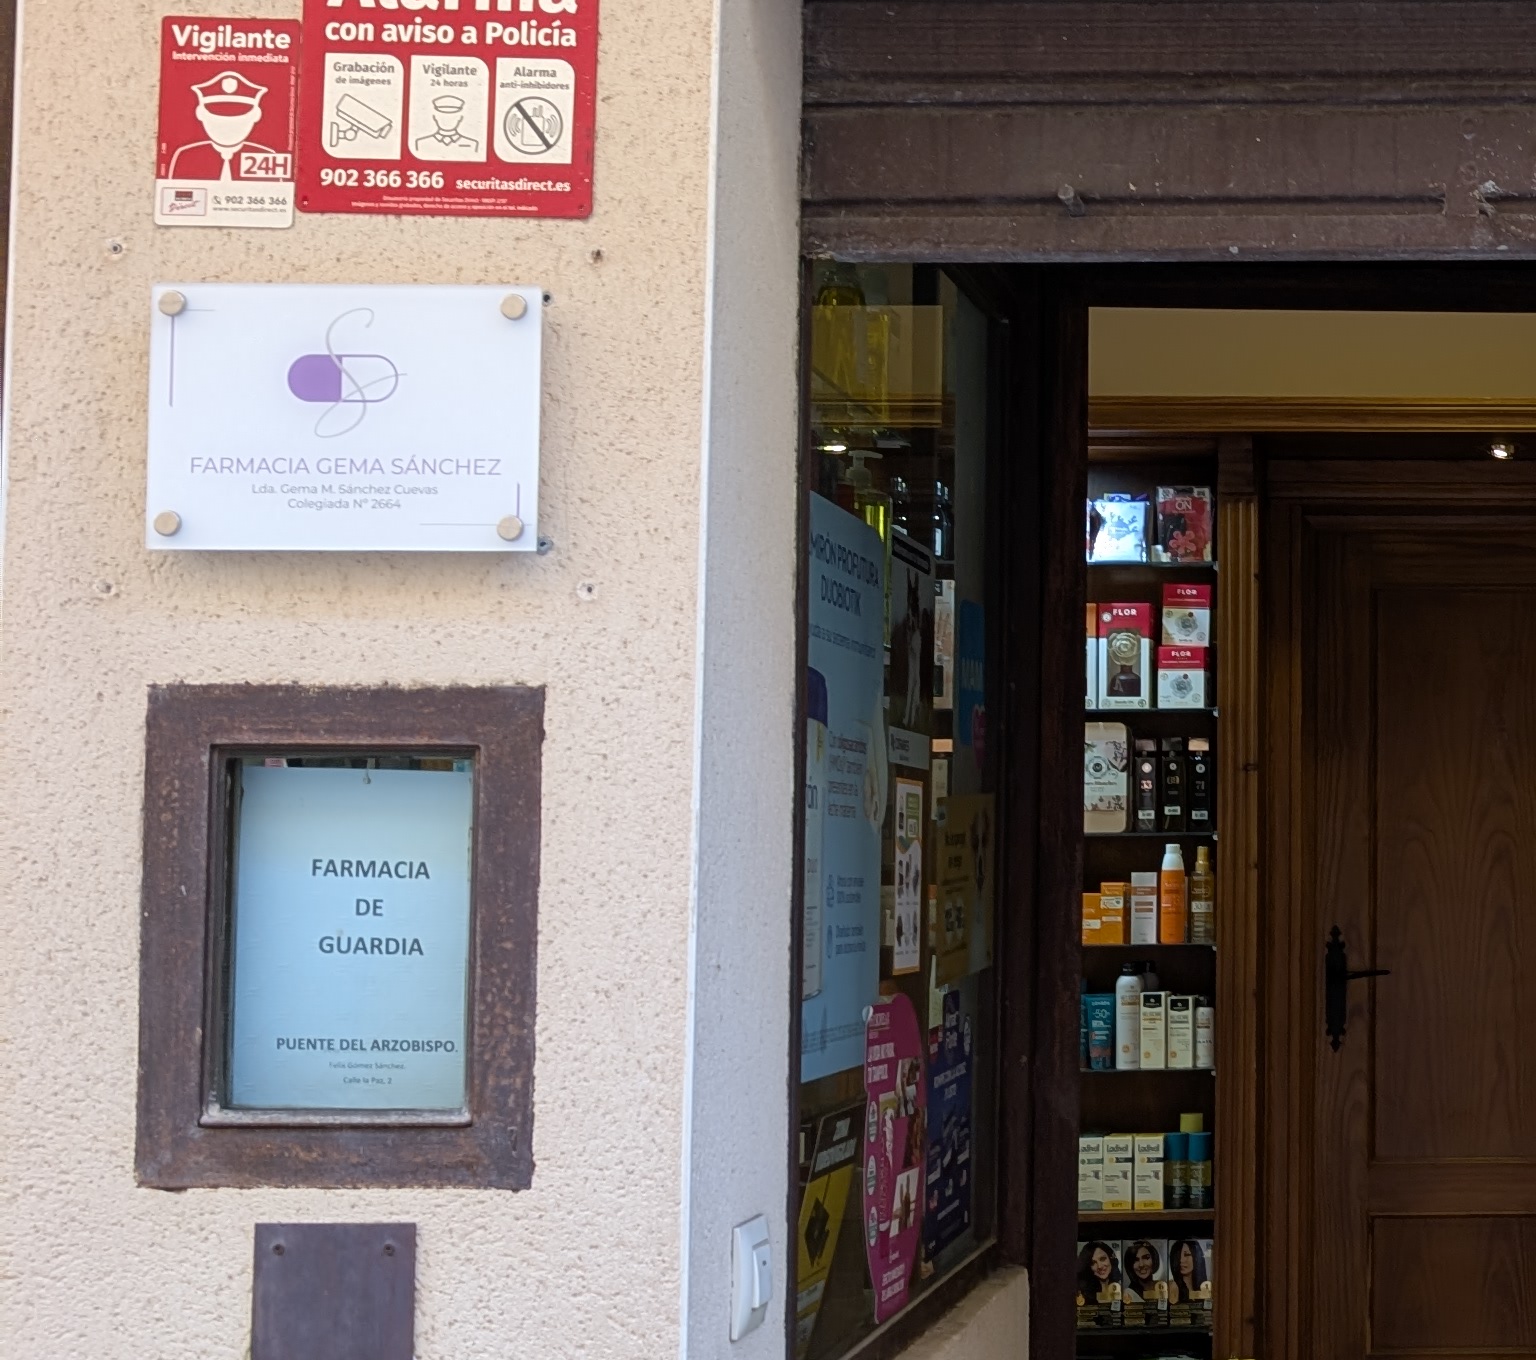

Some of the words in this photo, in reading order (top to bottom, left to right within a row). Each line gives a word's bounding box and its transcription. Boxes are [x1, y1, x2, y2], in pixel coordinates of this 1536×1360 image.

[172, 25, 291, 54] Vigilante
[325, 22, 375, 43] con
[381, 17, 454, 44] aviso
[461, 26, 478, 45] a
[485, 19, 577, 48] Policía
[172, 51, 236, 63] Intervención
[238, 52, 289, 64] inmediata
[333, 61, 396, 76] Grabación
[422, 63, 477, 78] Vigilante
[513, 65, 557, 79] Alarma
[335, 75, 347, 85] de
[349, 76, 392, 89] imágenes
[430, 79, 443, 88] 24
[445, 79, 469, 88] horas
[500, 80, 570, 91] anti-inhibidores
[243, 156, 288, 175] 24H
[320, 168, 359, 187] 902
[363, 169, 402, 188] 366
[405, 170, 445, 189] 366
[455, 177, 571, 194] securitasdirect.es
[225, 196, 244, 205] 902
[247, 196, 266, 206] 366
[269, 197, 288, 206] 366
[190, 456, 308, 475] FARMACIA
[316, 457, 385, 476] GEMA
[391, 454, 502, 477] SÁNCHEZ
[251, 484, 278, 495] Lda.
[280, 484, 318, 496] Gema
[321, 484, 336, 495] M.
[338, 483, 391, 496] Sánchez
[394, 484, 438, 495] Cuevas
[287, 498, 351, 511] Colegiada
[371, 498, 401, 510] 2664
[1113, 608, 1138, 617] FLOR
[311, 858, 431, 880] FARMACIA
[355, 898, 384, 917] DE
[318, 936, 425, 956] GUARDIA
[276, 1037, 334, 1052] PUENTE
[339, 1038, 367, 1052] DEL
[370, 1039, 459, 1054] ARZOBISPO.
